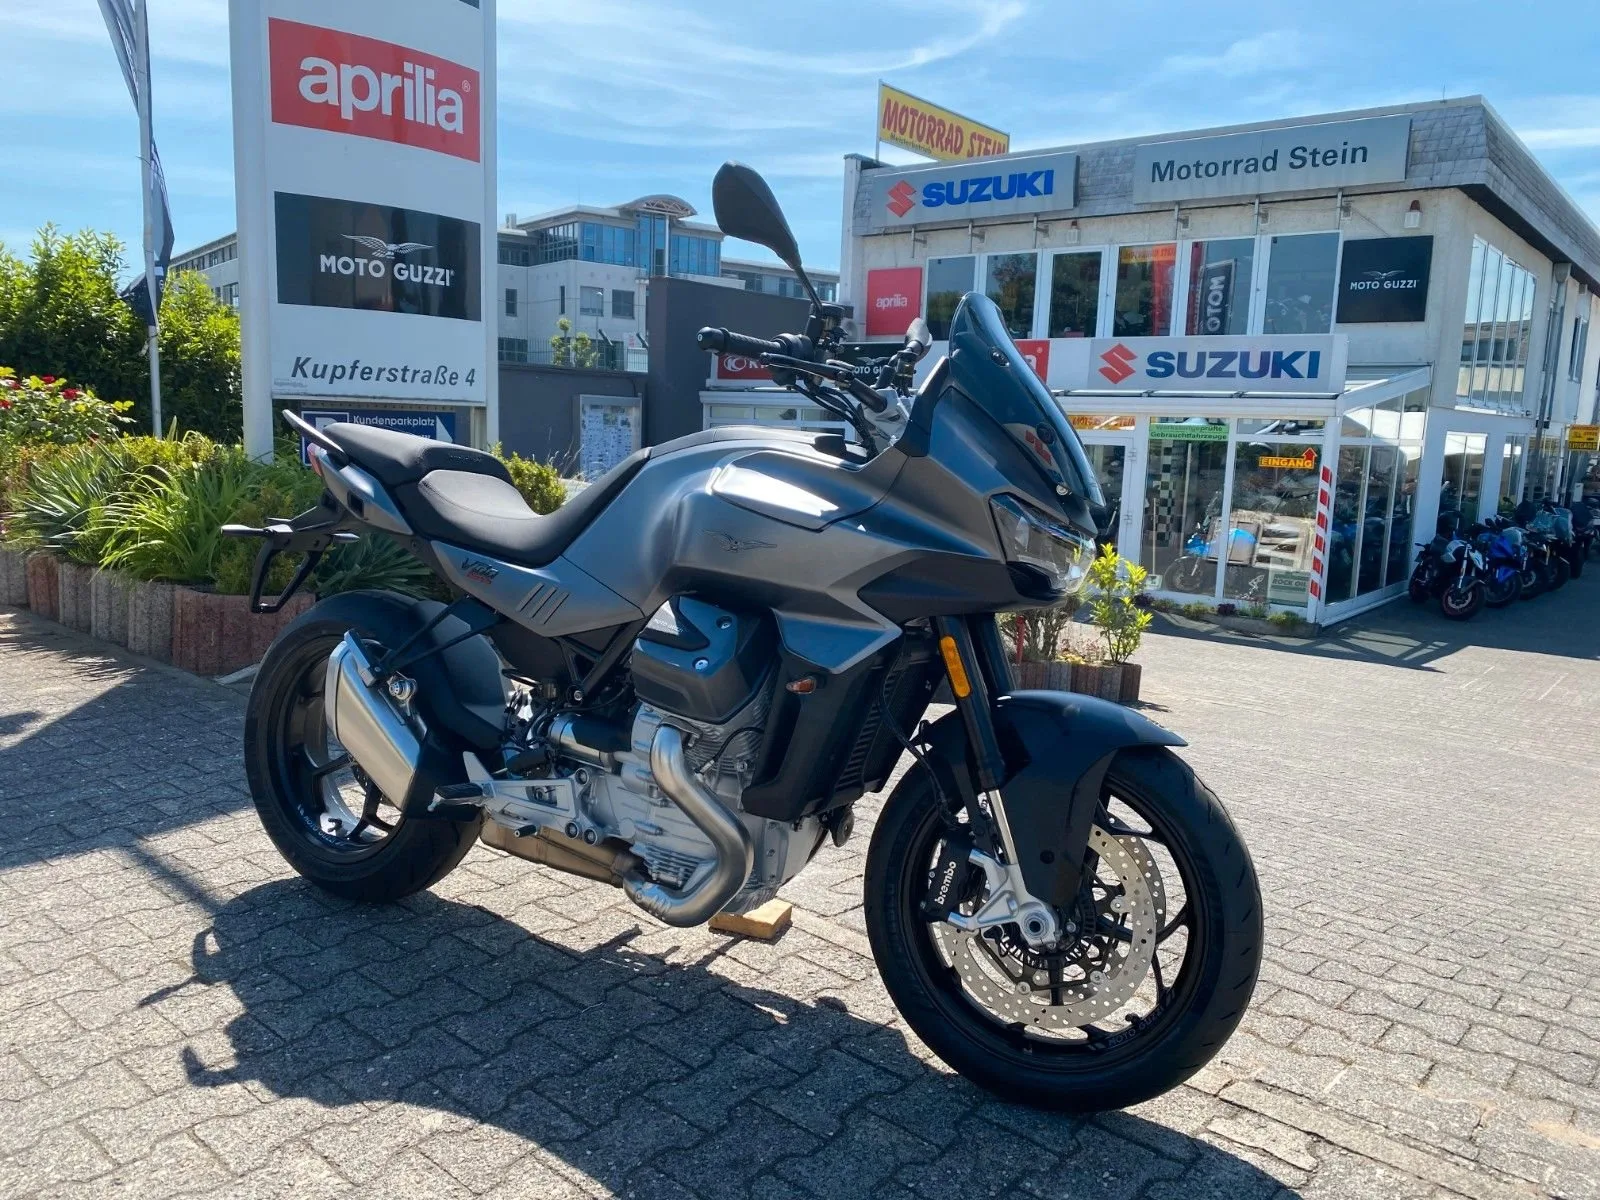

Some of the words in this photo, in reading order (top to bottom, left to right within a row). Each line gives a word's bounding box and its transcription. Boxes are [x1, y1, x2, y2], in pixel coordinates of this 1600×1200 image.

[299, 56, 465, 134] aprilia
[882, 98, 964, 155] MOTORRAD
[1151, 149, 1278, 182] Motorrad
[1288, 141, 1368, 170] Stein
[922, 169, 1054, 207] SUZUKI
[320, 254, 385, 279] MOTO
[393, 262, 451, 287] GUZZI
[1350, 281, 1380, 290] MOTO
[1383, 279, 1417, 289] GUZZI
[875, 293, 908, 310] aprilia
[291, 356, 459, 386] Kupferstraße
[464, 368, 476, 387] 4
[1145, 350, 1321, 379] SUZUKI
[353, 415, 435, 427] Kundenparkplatz
[1261, 458, 1312, 467] EINGANG
[934, 861, 957, 905] brembo
